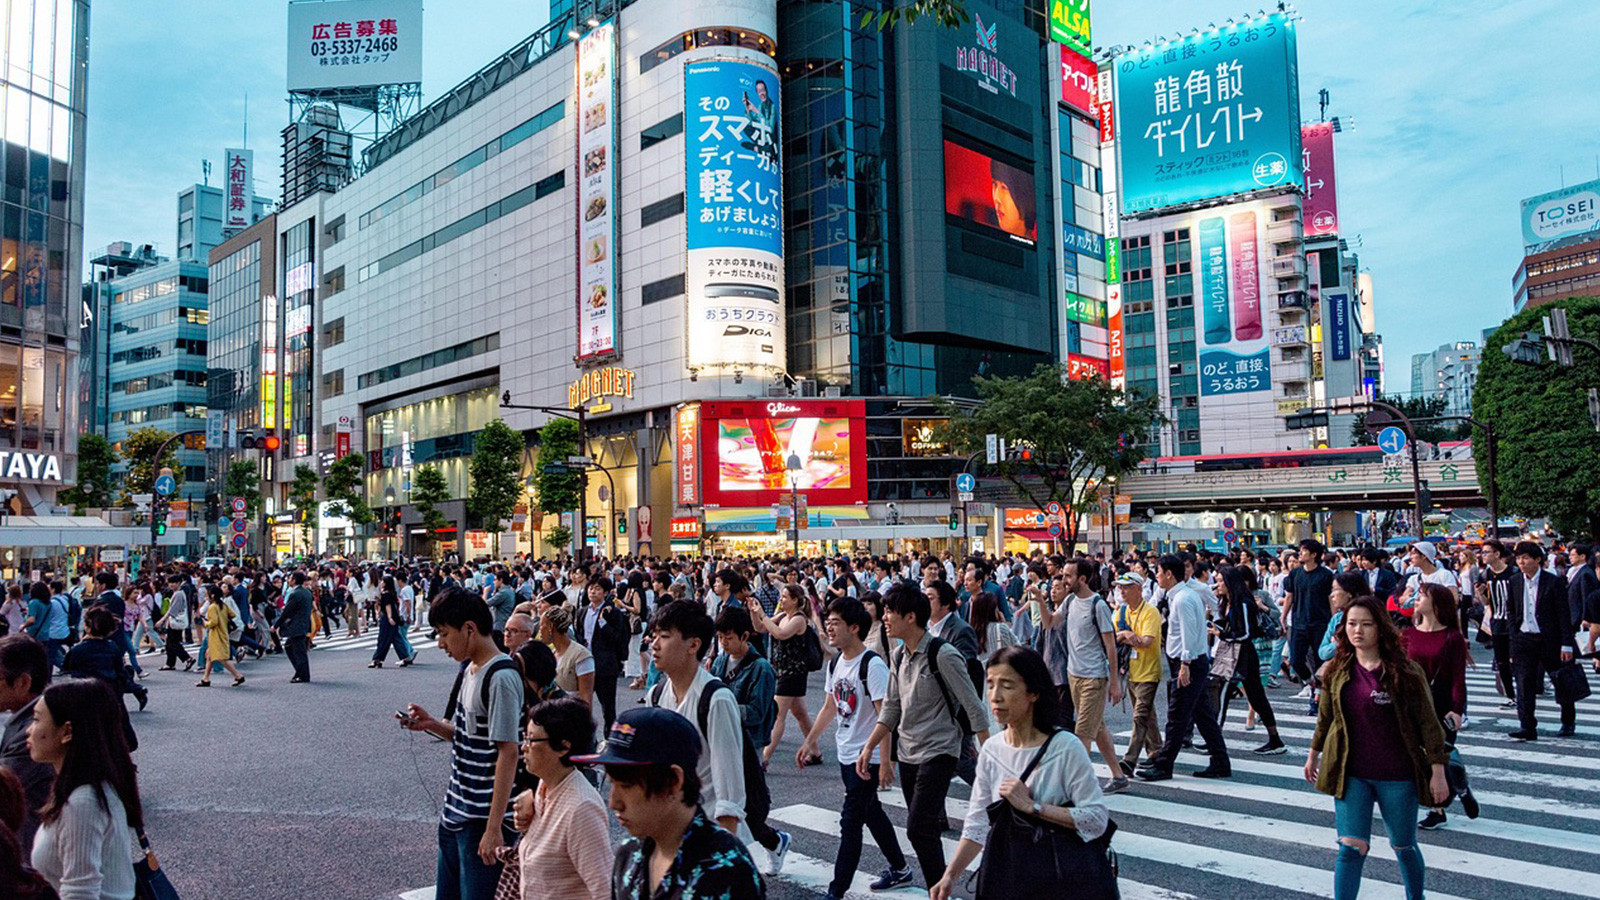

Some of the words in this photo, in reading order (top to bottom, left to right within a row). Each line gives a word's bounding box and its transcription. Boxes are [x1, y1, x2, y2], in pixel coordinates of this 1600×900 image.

[312, 19, 398, 40] 広告募集
[1052, 0, 1091, 41] ALSA
[311, 37, 398, 56] 03-5337-2468
[1122, 22, 1277, 73] のど、直接、うるおう
[319, 53, 390, 66] 株式会社タップ
[689, 66, 720, 74] Panasonic
[956, 46, 1017, 97] MAGNET
[1062, 62, 1098, 96] アイフル
[1154, 58, 1244, 115] 龍角散
[698, 96, 730, 111] その
[1103, 112, 1112, 141] アイフル
[1144, 103, 1263, 157] ダイレクト
[699, 145, 778, 175] ディーガが
[1155, 156, 1205, 175] スティック
[1255, 160, 1284, 179] 生薬
[230, 154, 246, 211] 大和証券
[699, 169, 778, 210] 軽くして
[700, 206, 779, 231] あげましょう!
[1315, 214, 1334, 227] 生薬
[1538, 199, 1594, 222] TOSEI
[1540, 213, 1594, 231] トーセイ株式会社
[723, 325, 772, 337] DIGA
[1111, 330, 1121, 357] アコム
[1204, 358, 1269, 376] のど、直接、
[569, 367, 635, 409] MAGNET
[1211, 375, 1260, 392] うるおう
[767, 402, 802, 416] Glico
[682, 424, 694, 501] 天津甘栗
[1328, 470, 1347, 481] JR
[1440, 463, 1459, 481] 谷
